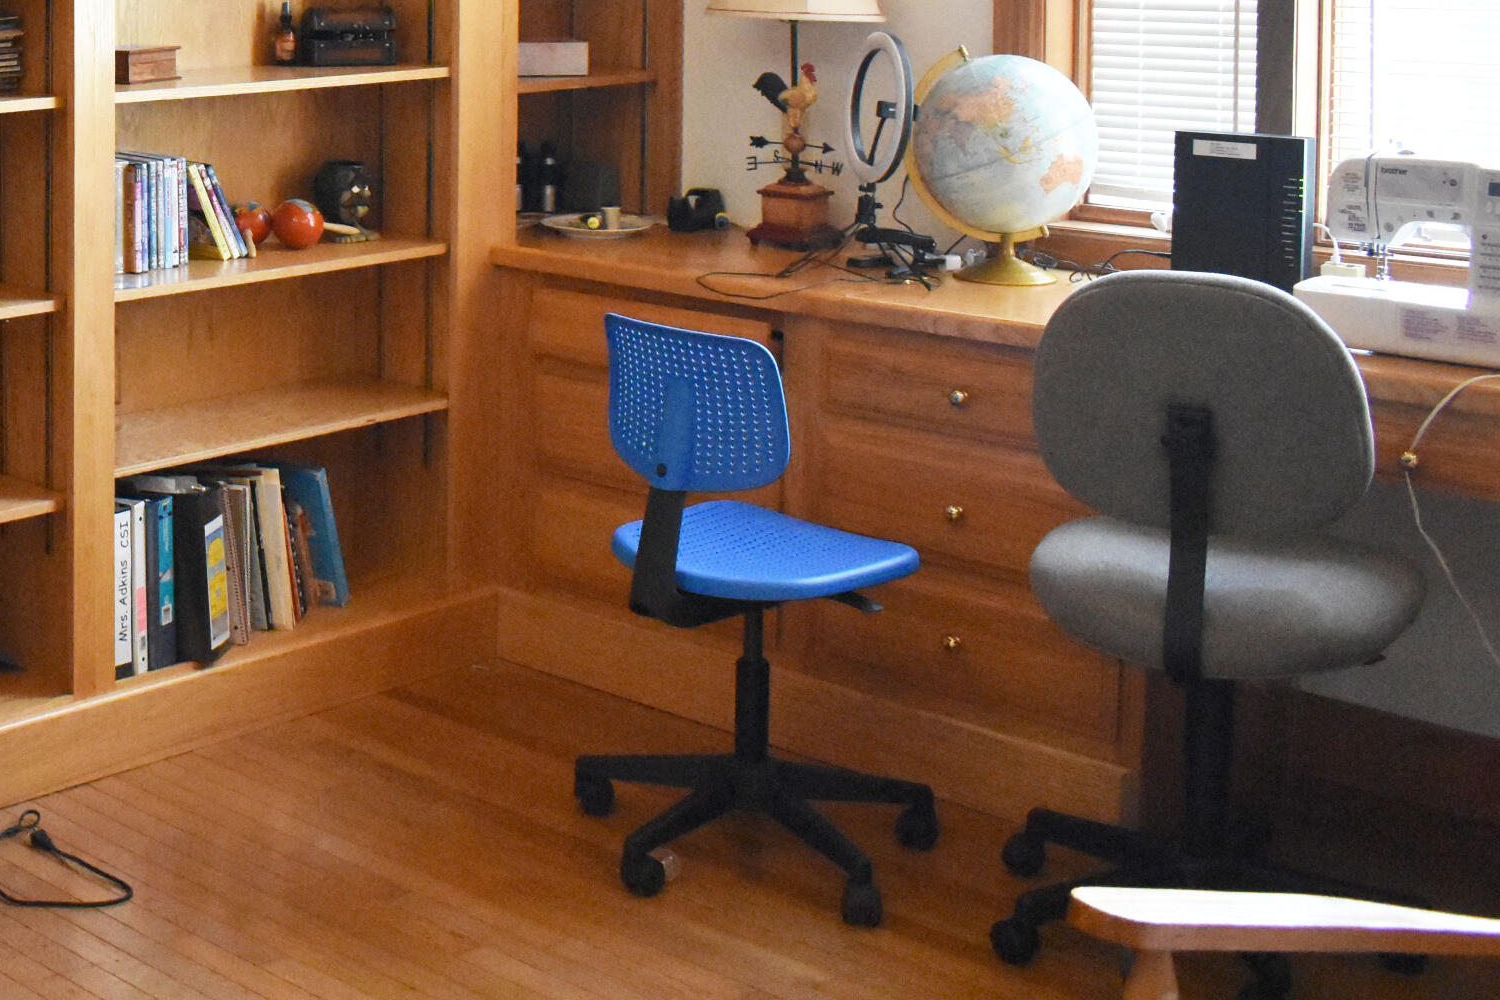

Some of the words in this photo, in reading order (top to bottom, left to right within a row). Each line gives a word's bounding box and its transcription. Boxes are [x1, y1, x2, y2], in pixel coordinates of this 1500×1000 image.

[1380, 166, 1409, 176] brother
[119, 521, 128, 548] CSI
[118, 560, 127, 604] Adkins
[119, 609, 127, 641] Mrs.
